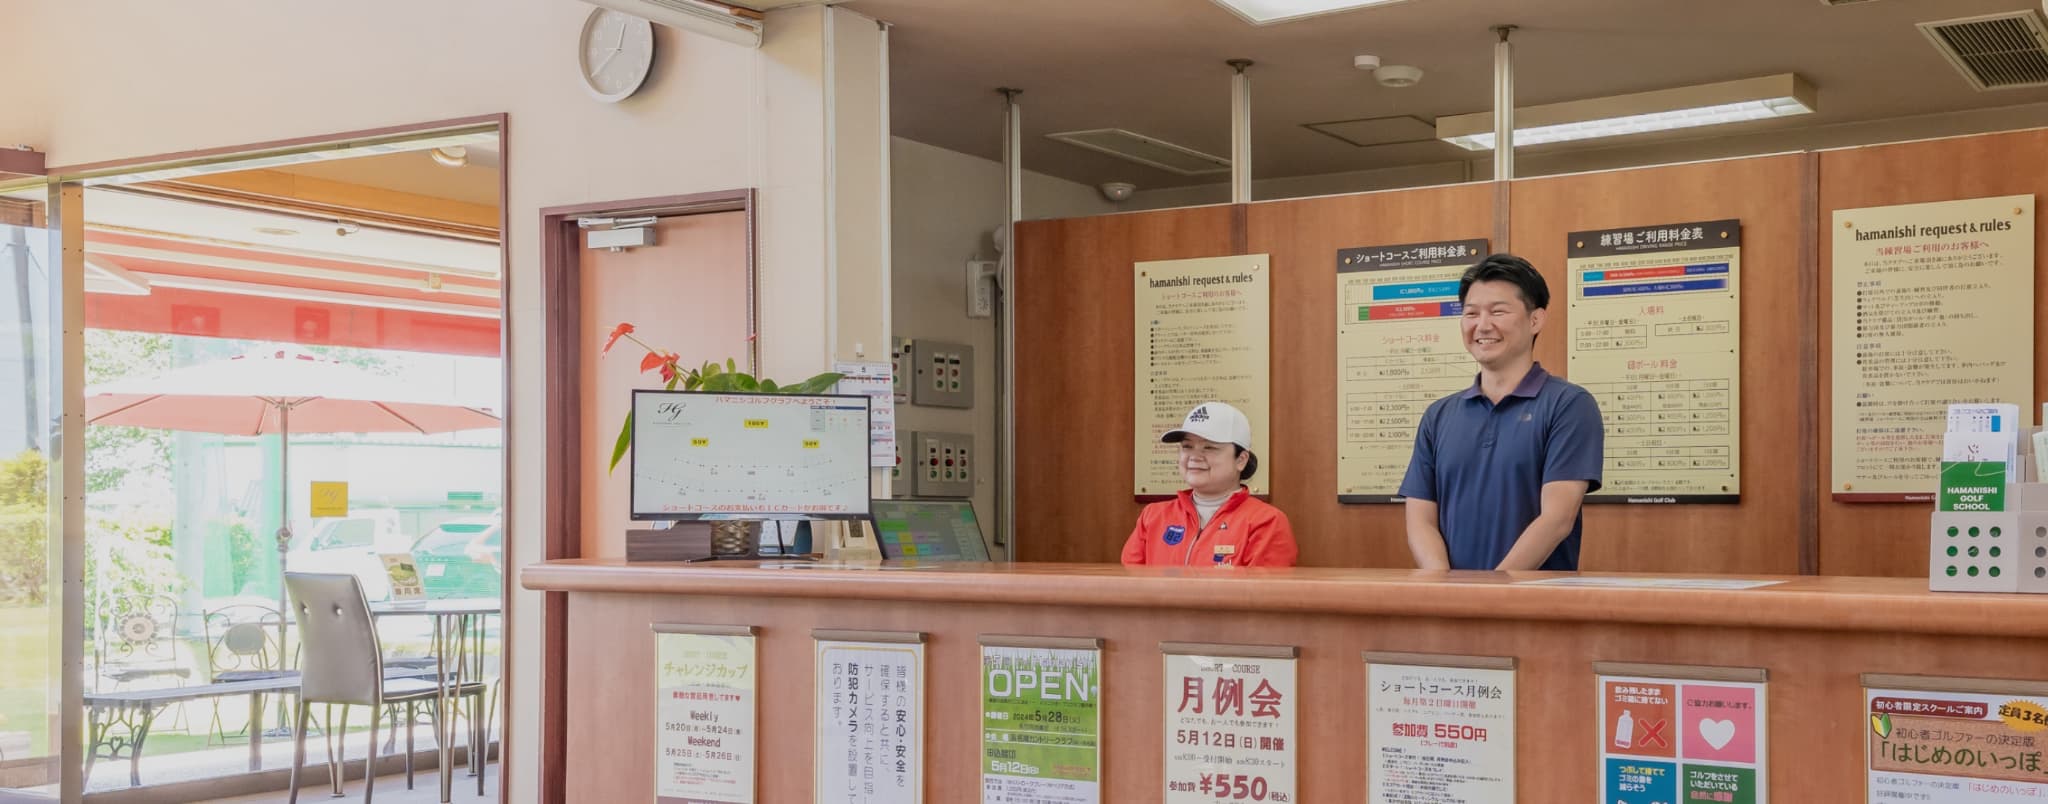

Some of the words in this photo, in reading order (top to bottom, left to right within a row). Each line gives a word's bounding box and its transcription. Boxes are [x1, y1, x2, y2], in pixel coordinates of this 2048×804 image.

[1600, 228, 1704, 247] 練習場ご利用料金表
[1856, 225, 1916, 241] hamanishi
[1920, 222, 1967, 239] request
[1970, 222, 1978, 232] &
[1980, 218, 2012, 232] rules
[1356, 246, 1466, 263] ショートコースご利用料金表
[1150, 276, 1190, 288] hamanishi
[1192, 275, 1224, 288] request
[1232, 272, 1253, 283] rules
[664, 660, 748, 678] チャレンジカップ
[1232, 664, 1260, 674] COURSE
[989, 669, 1088, 701] OPEN
[1381, 680, 1502, 699] ショートコース月例会
[1177, 676, 1283, 719] 月例会
[690, 710, 718, 723] Weekly
[1876, 701, 1983, 715] 初心者限定スクールご案内
[896, 665, 906, 788] 皆様の安心・安全を
[1434, 723, 1487, 742] 550円
[688, 736, 721, 748] Weekend
[1896, 727, 2035, 747] 初心者ゴルファーの決定版
[1690, 770, 1739, 782] ゴルフをさせて
[1690, 780, 1738, 791] いただいている
